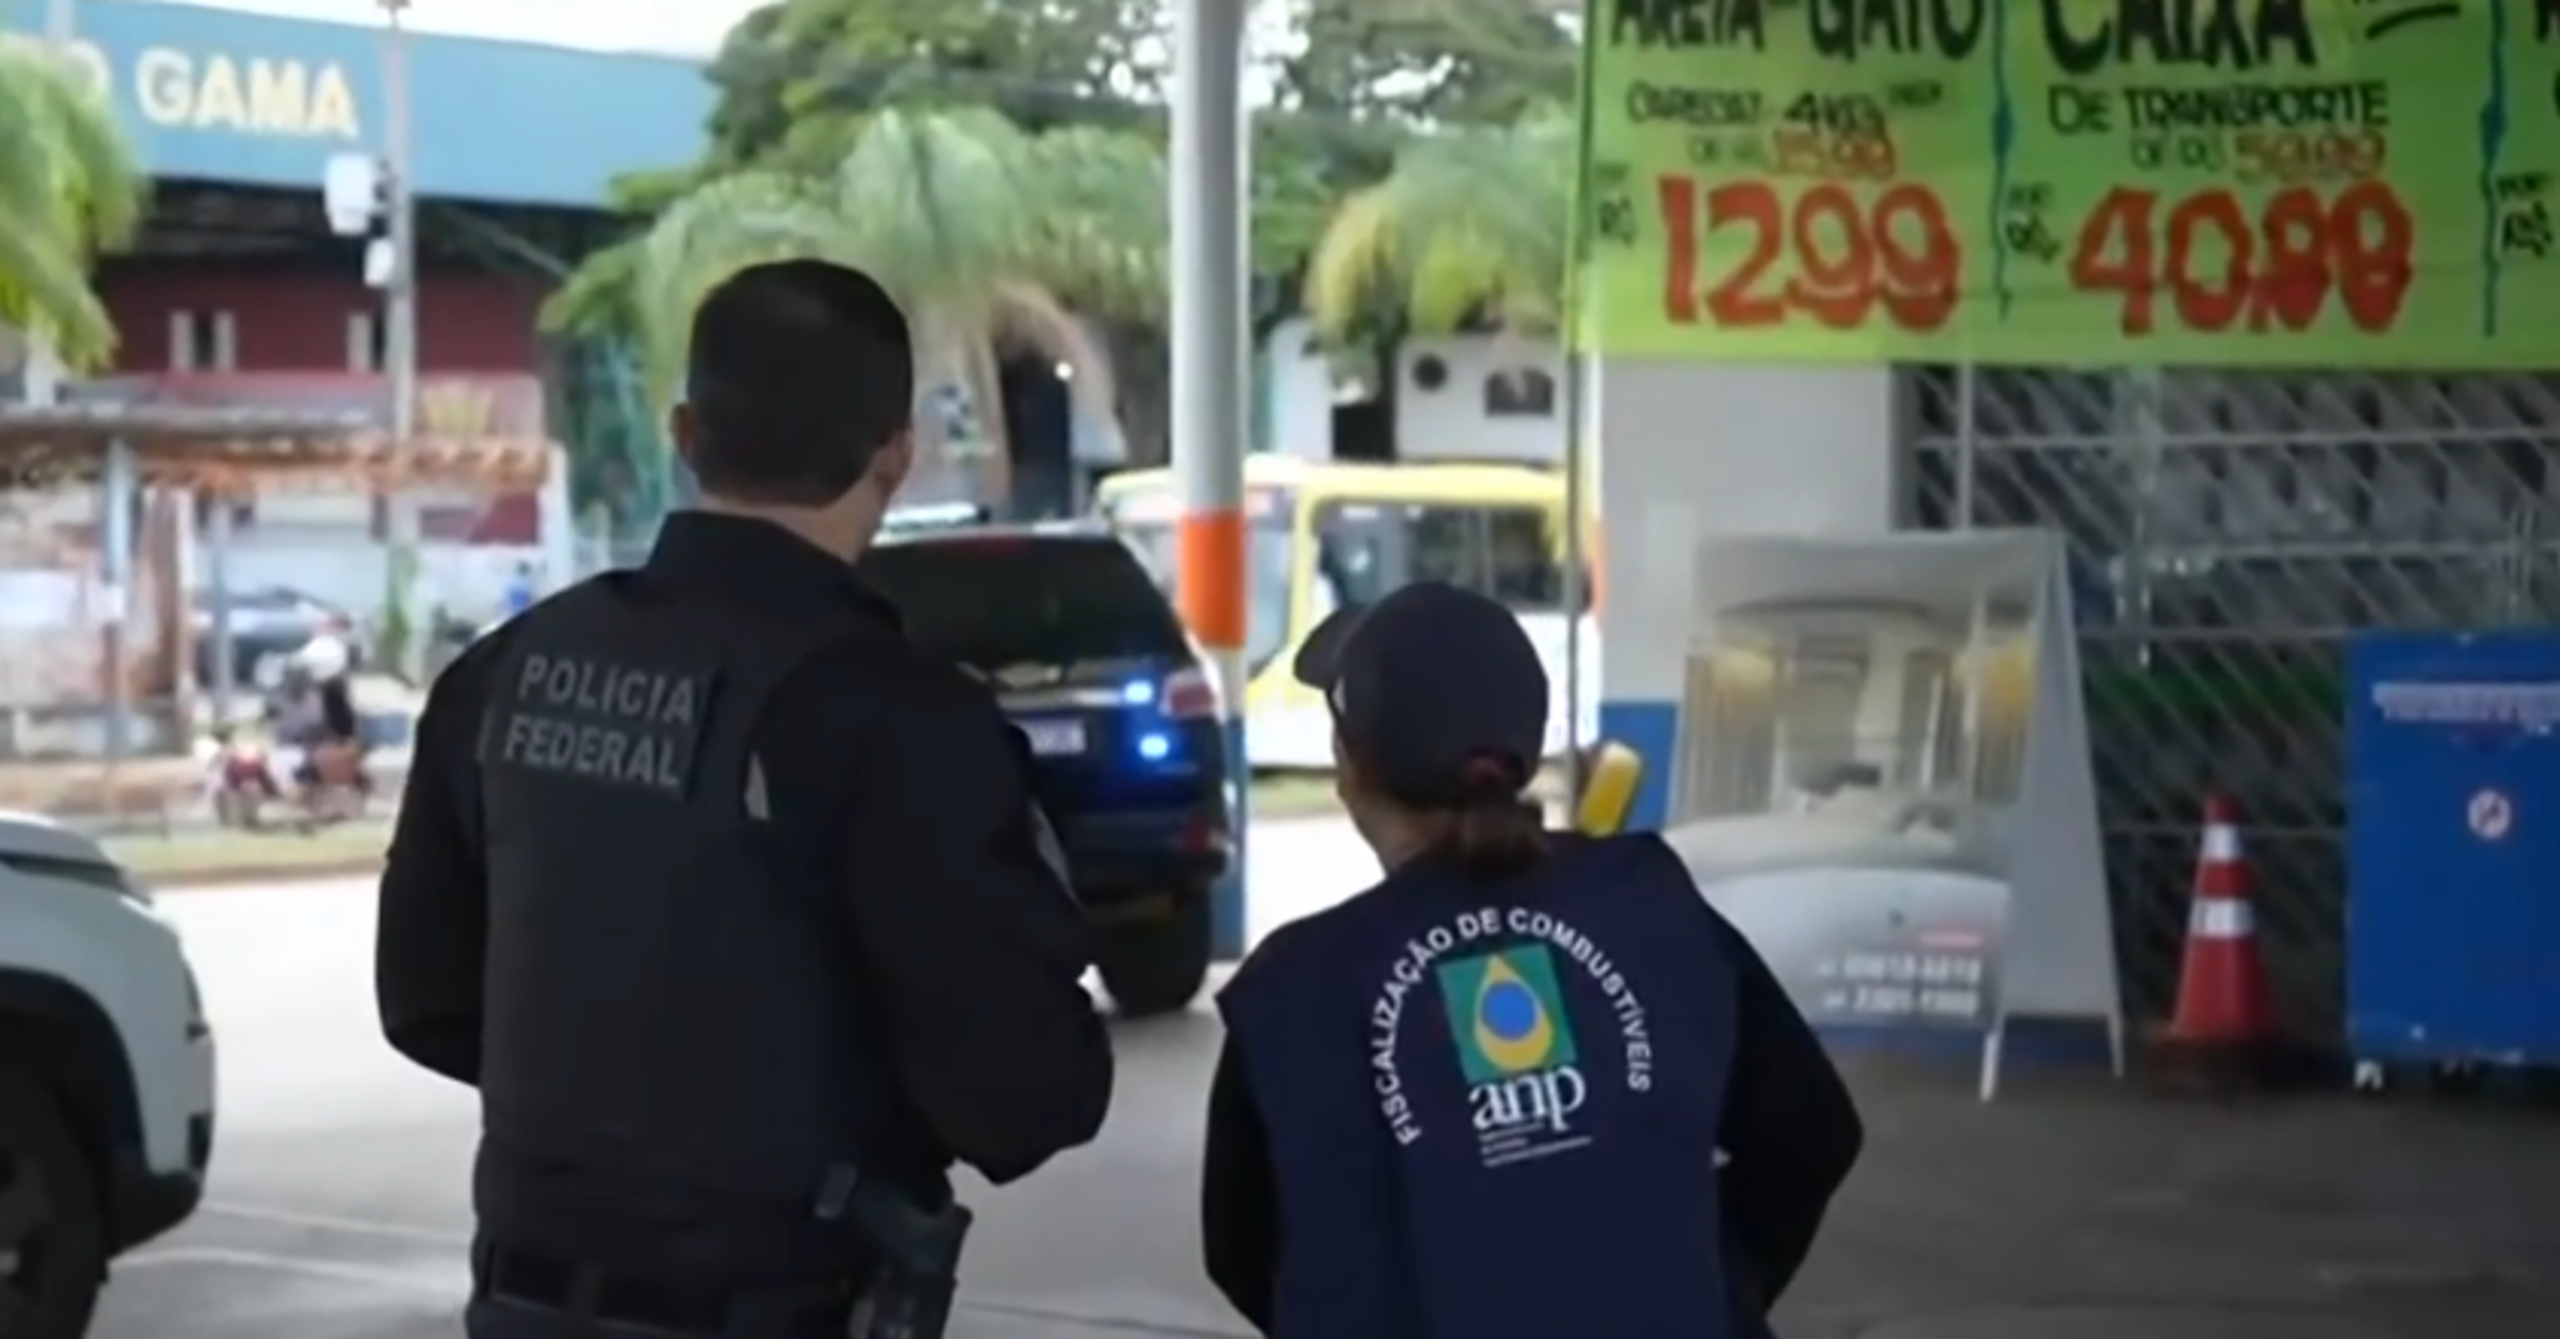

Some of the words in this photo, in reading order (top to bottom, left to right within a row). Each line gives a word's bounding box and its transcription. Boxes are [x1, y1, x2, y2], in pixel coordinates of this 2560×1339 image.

[136, 47, 358, 138] GAMA
[2049, 85, 2112, 134] DE
[2122, 81, 2390, 130] TRANSPORTE
[503, 712, 681, 787] FEDERAL
[1370, 926, 1454, 1145] FISCALIZAÇÃO
[1456, 907, 1500, 940] DE
[1508, 907, 1652, 1092] COMBUSTÍVEIS
[1468, 1065, 1586, 1131] anp
